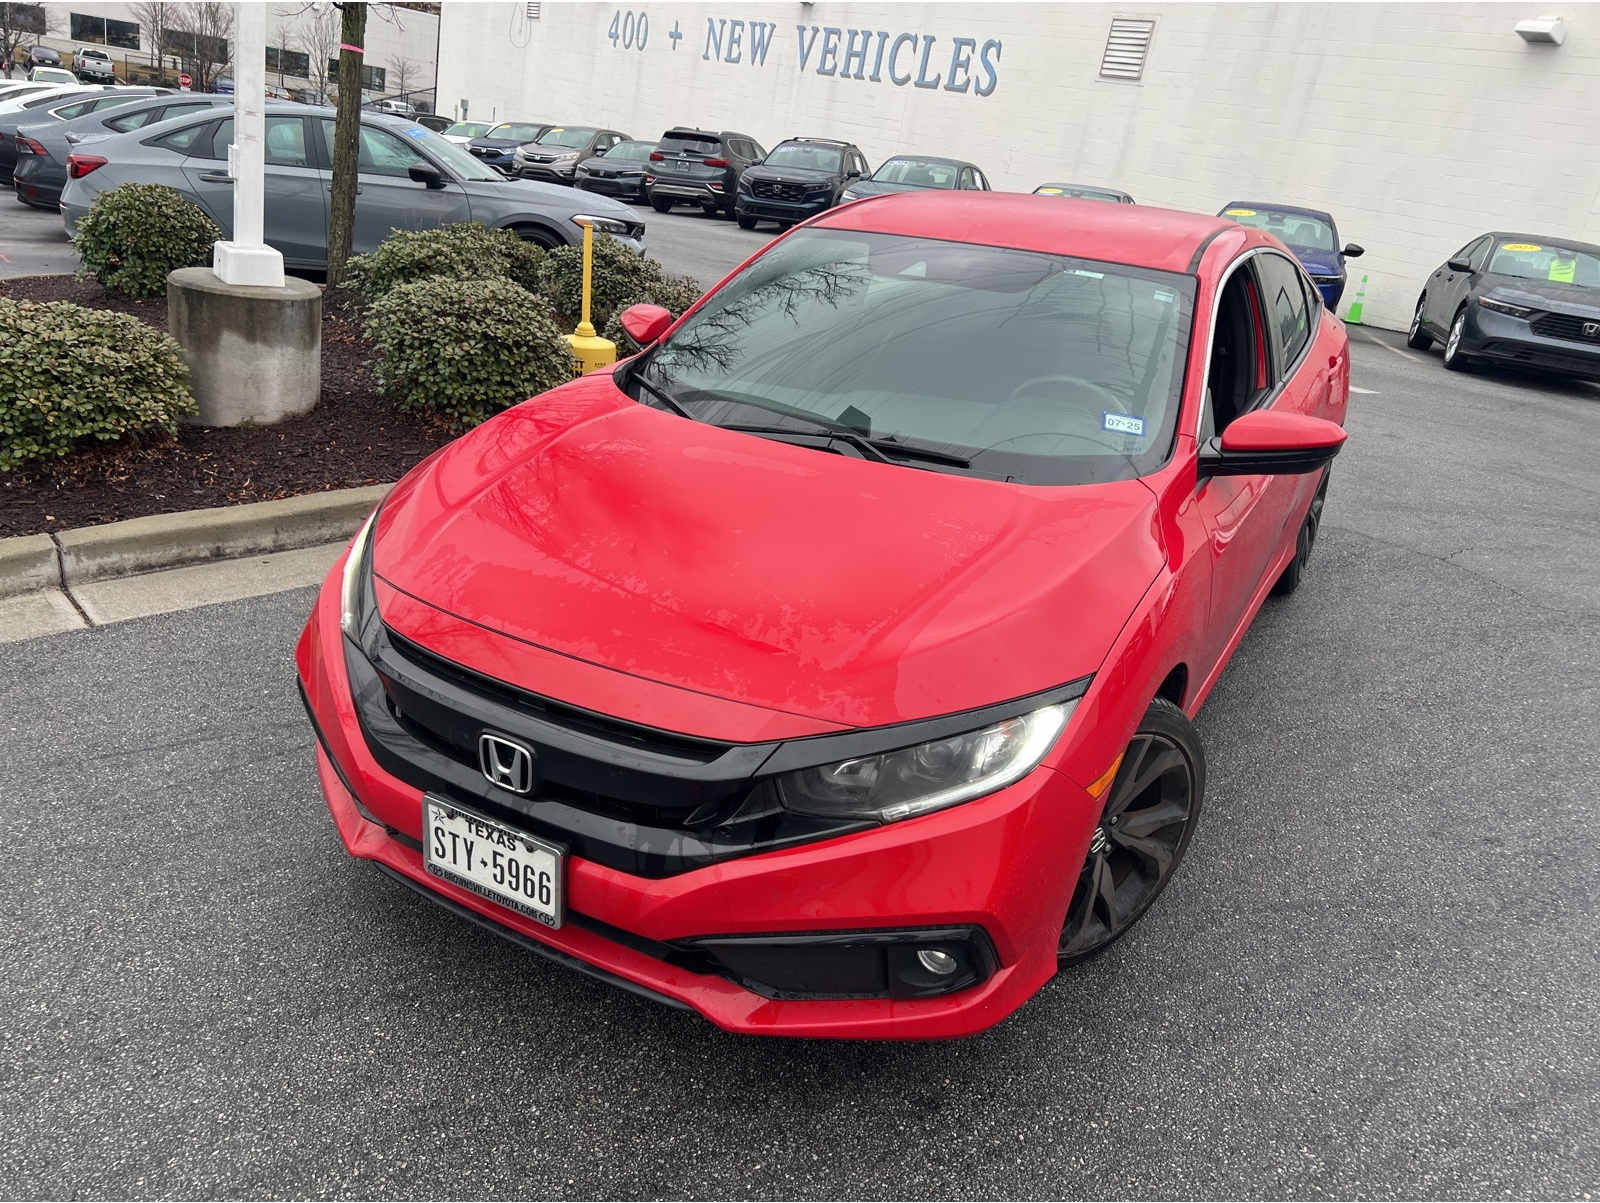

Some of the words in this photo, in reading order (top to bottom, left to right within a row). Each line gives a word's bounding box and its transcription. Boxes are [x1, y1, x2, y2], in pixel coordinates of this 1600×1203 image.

[607, 9, 649, 52] 400
[668, 20, 683, 51] +
[702, 16, 776, 67] NEW
[796, 24, 1002, 97] VEHICLES
[434, 826, 474, 871] STY
[492, 850, 551, 906] 5966
[466, 820, 517, 852] TEXAS
